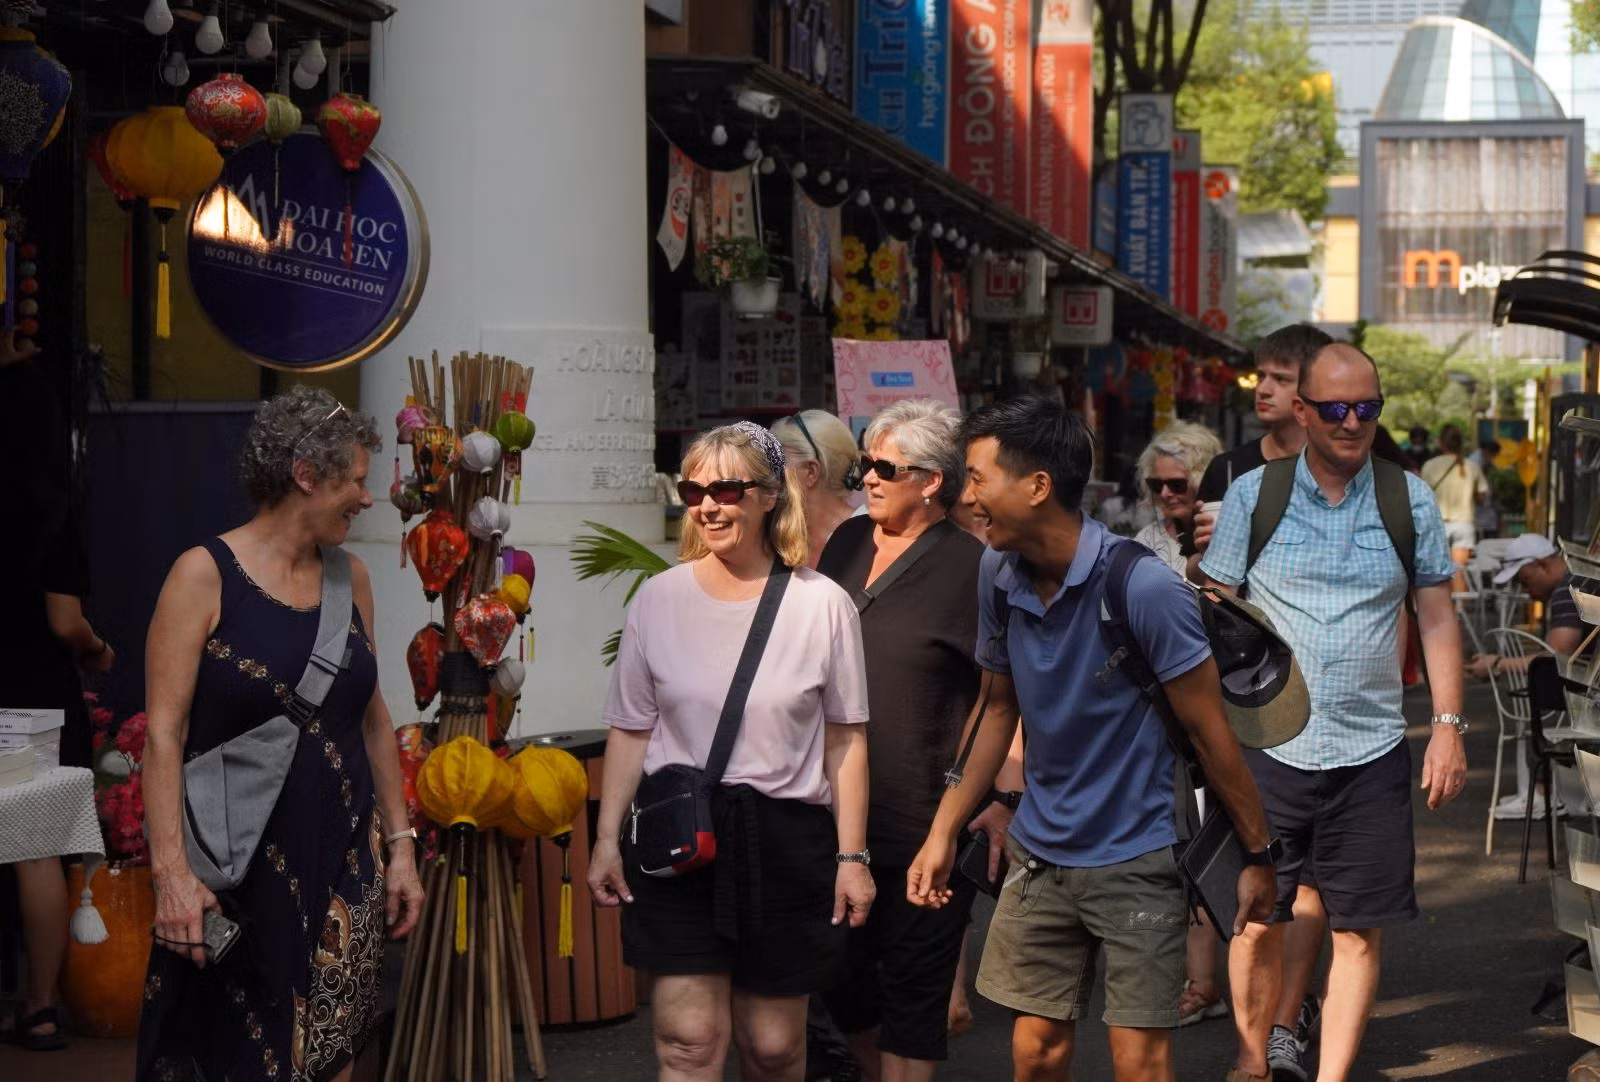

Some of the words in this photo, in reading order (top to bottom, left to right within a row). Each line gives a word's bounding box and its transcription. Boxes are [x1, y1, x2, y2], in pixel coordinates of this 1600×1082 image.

[959, 22, 996, 146] ĐÔNG
[334, 210, 397, 243] HỌC
[204, 246, 253, 266] WORLD
[258, 257, 300, 277] CLASS
[304, 268, 385, 296] EDUCATION
